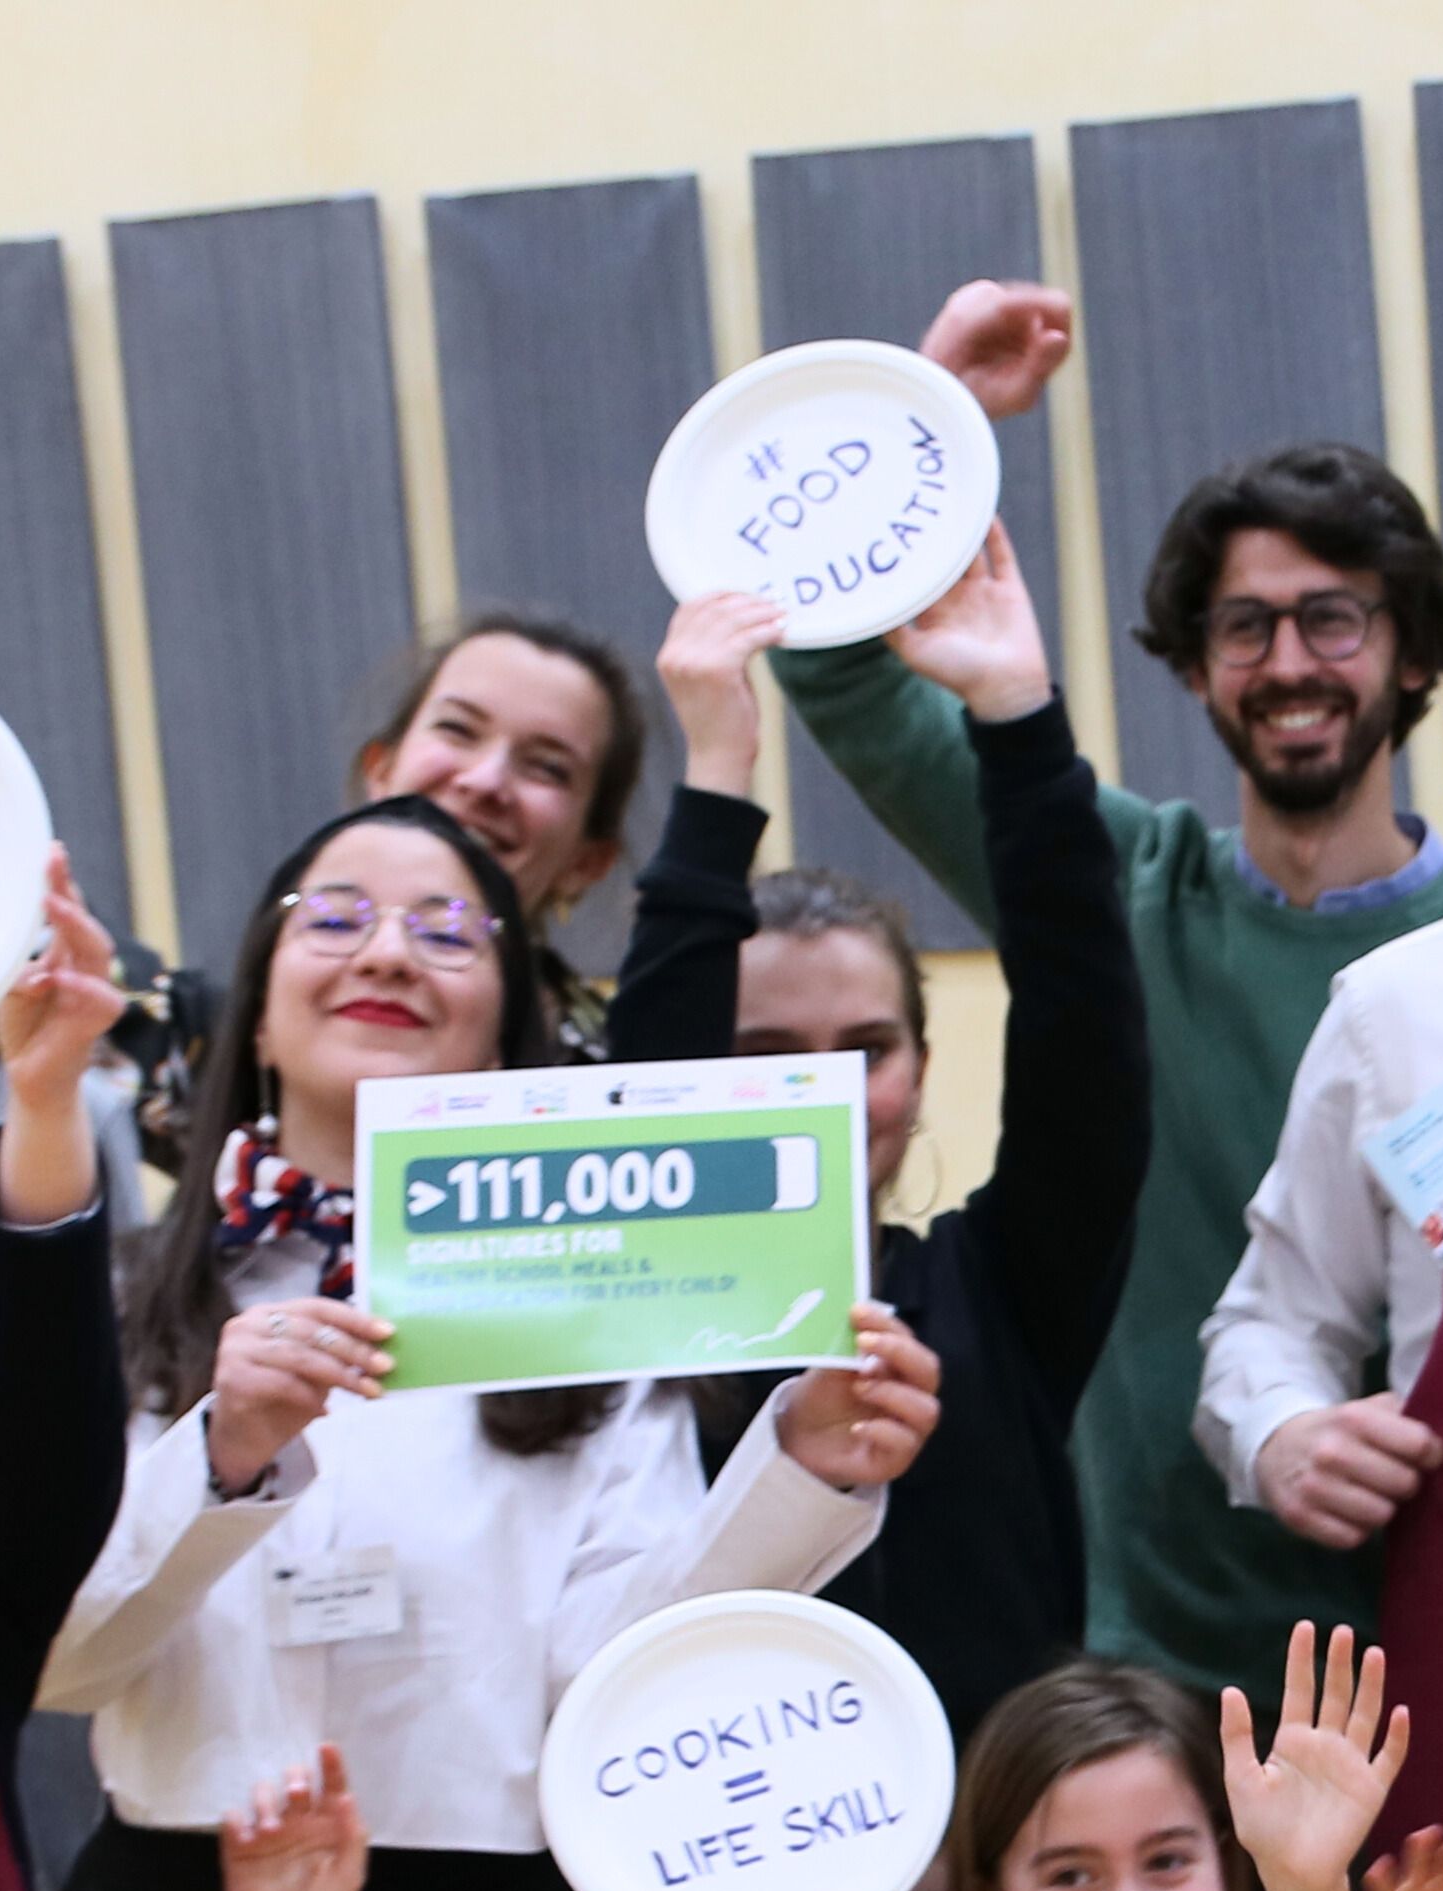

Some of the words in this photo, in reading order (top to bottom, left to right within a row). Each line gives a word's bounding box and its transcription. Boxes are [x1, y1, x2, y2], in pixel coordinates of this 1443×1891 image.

[738, 441, 871, 555] FOOD
[570, 1228, 623, 1255] FOR
[595, 1681, 864, 1797] COOKING
[652, 1823, 766, 1887] LIFE
[782, 1781, 905, 1852] SKILL
